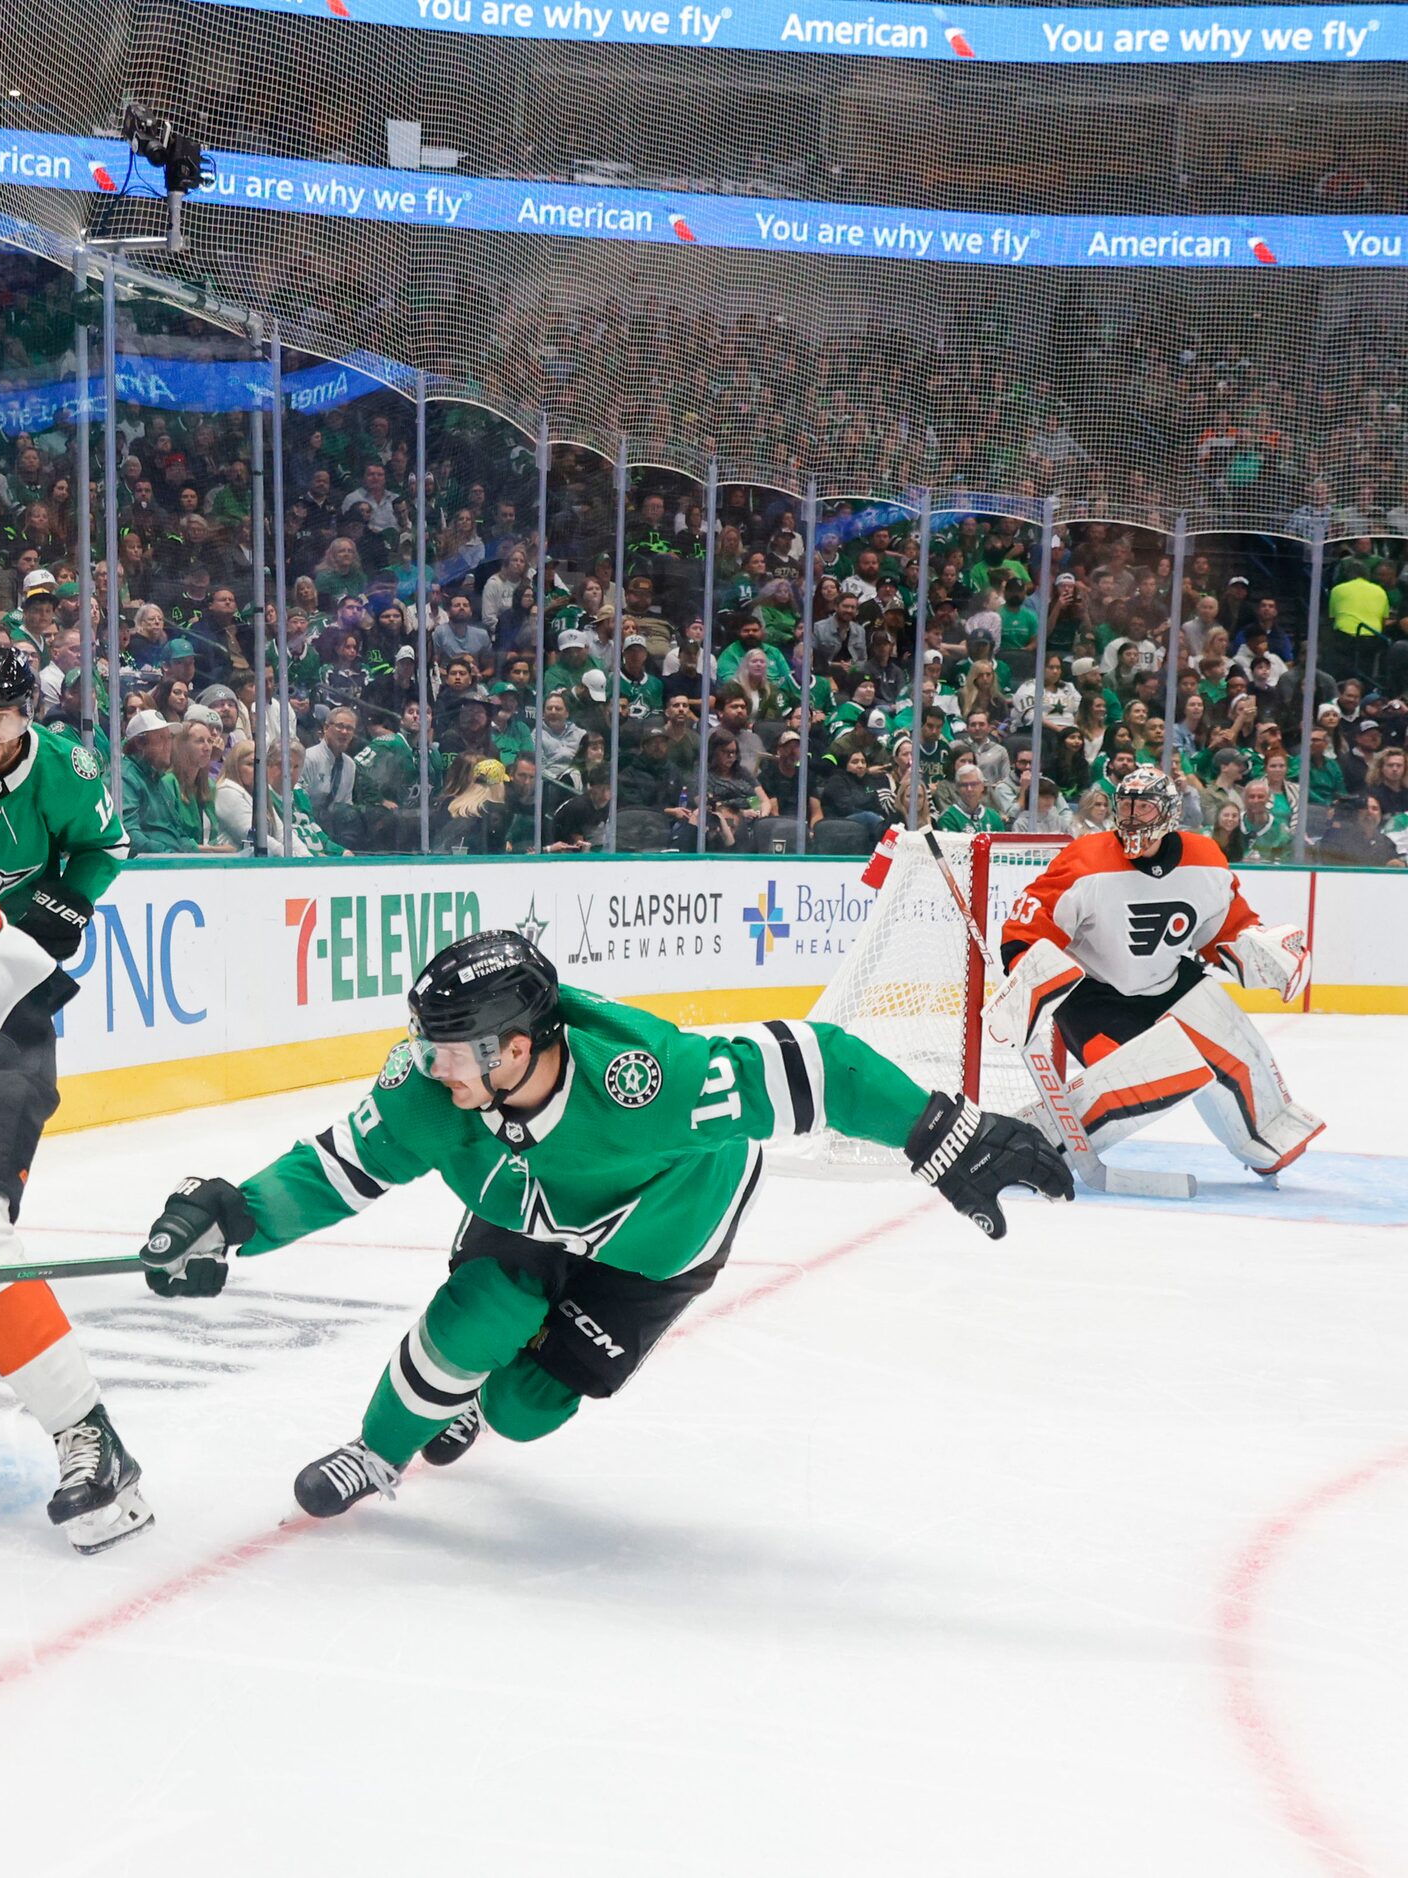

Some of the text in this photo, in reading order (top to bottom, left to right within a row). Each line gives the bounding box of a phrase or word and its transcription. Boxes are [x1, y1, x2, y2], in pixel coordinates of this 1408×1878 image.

[416, 0, 471, 22] You
[481, 3, 534, 28] are
[544, 1, 612, 37] why
[622, 10, 670, 36] we
[780, 13, 929, 49] American
[1042, 23, 1104, 52] You
[1113, 27, 1170, 52] are
[1178, 23, 1252, 58] why
[1261, 27, 1314, 51] we
[199, 172, 236, 195] ou
[245, 176, 293, 201] are
[302, 180, 365, 214] why
[373, 189, 417, 213] we
[517, 197, 652, 232] American
[755, 212, 808, 242] You
[817, 223, 864, 245] are
[872, 223, 933, 256] why
[941, 232, 984, 254] we
[1087, 230, 1231, 257] American
[1342, 230, 1401, 257] You
[608, 893, 723, 928] SLAPSHOT
[796, 884, 874, 934] Baylor
[1010, 891, 1042, 925] 33
[608, 934, 722, 960] REWARDS
[969, 1152, 992, 1174] COVERT
[558, 1300, 625, 1358] CCM
